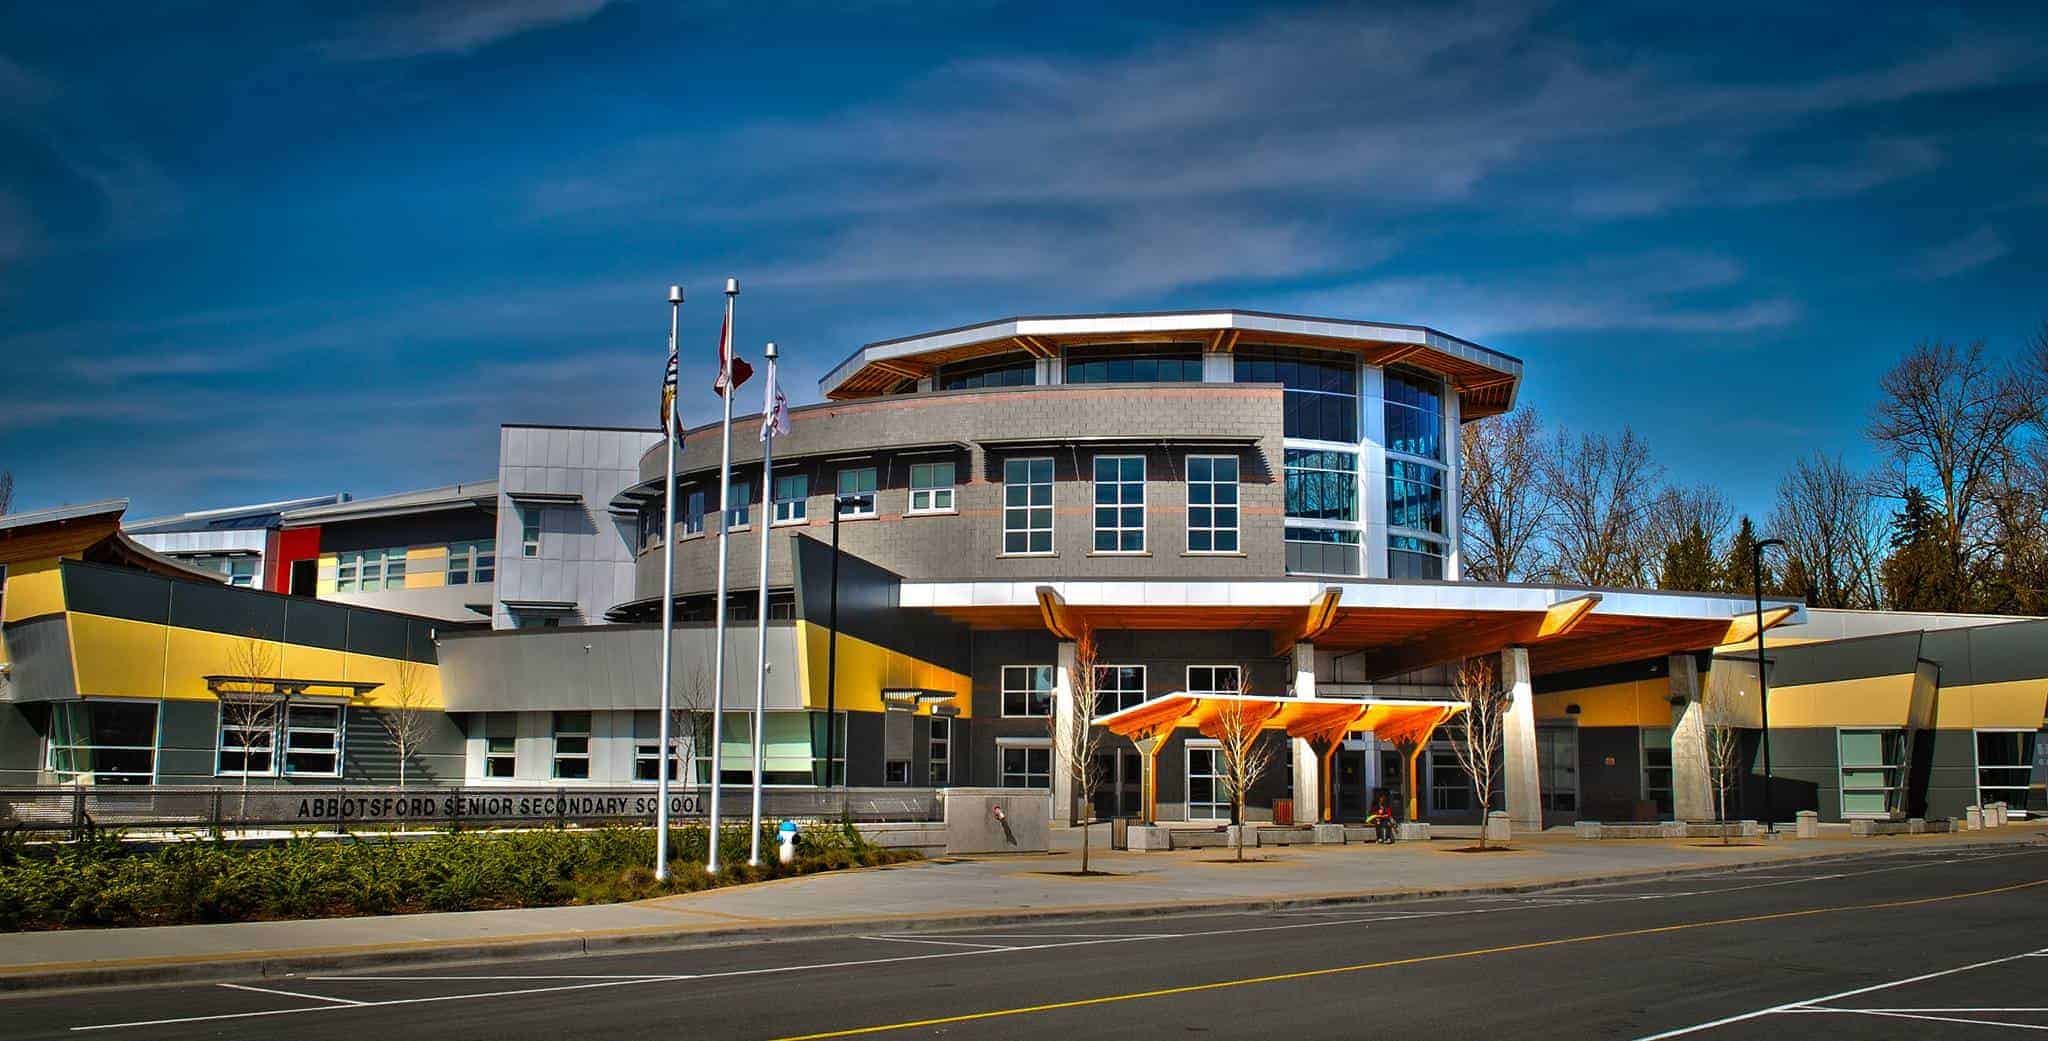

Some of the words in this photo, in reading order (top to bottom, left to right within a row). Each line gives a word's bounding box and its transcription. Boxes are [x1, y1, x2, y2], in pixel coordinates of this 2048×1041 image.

[297, 798, 435, 818] ABBOTSFORD
[444, 797, 513, 816] SENIOR
[519, 797, 628, 815] SECONDARY
[635, 797, 703, 813] SCOOL
